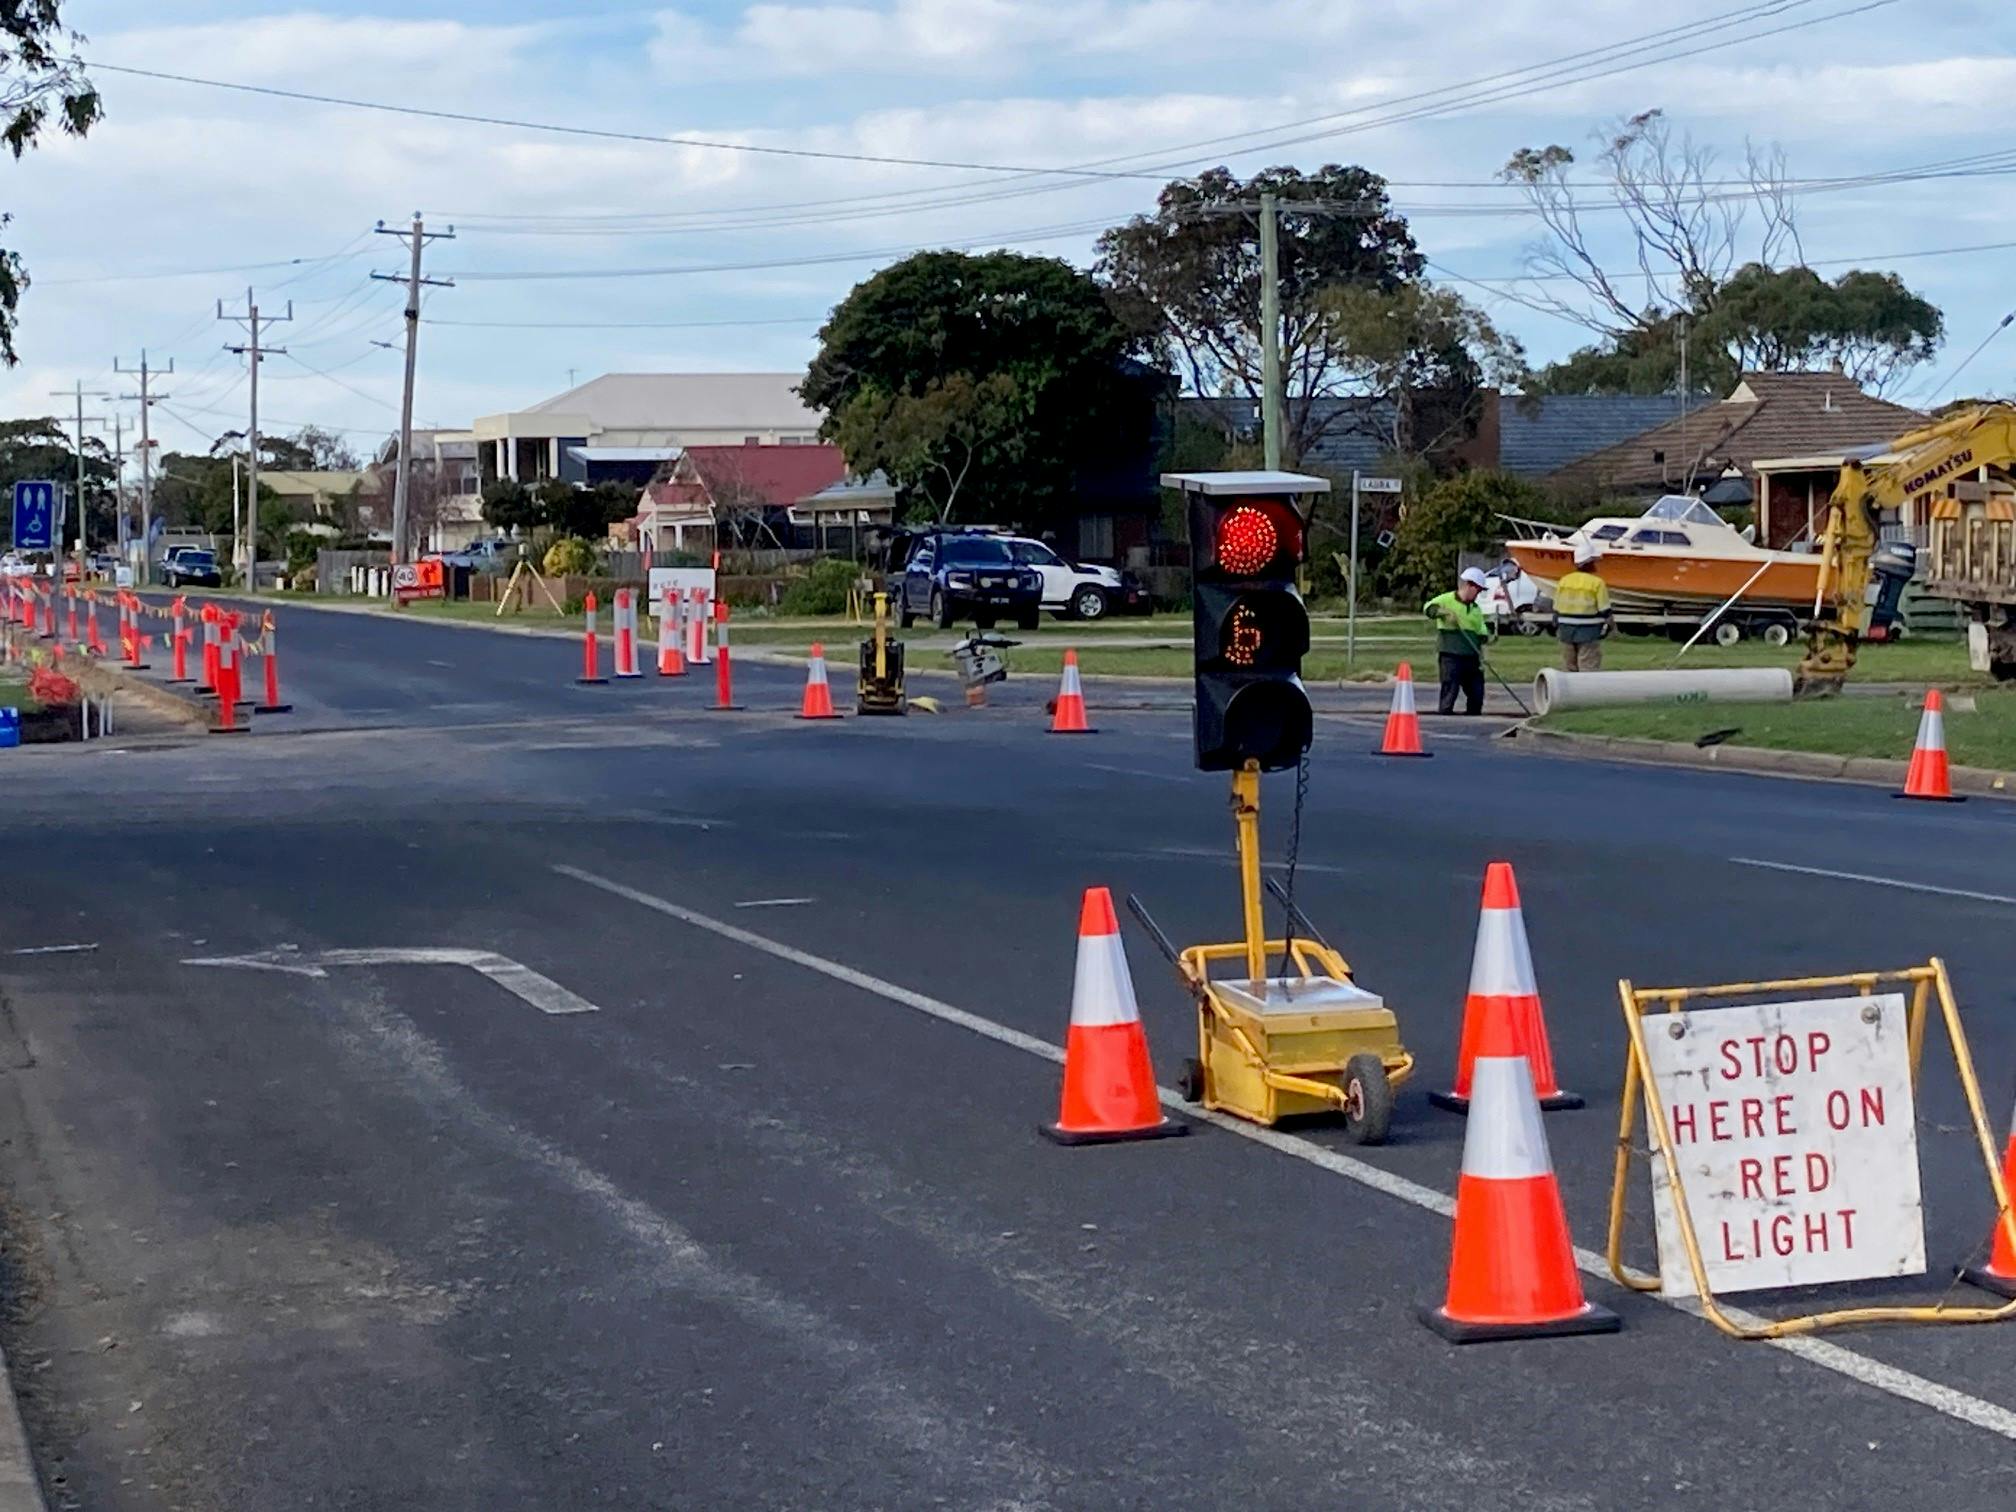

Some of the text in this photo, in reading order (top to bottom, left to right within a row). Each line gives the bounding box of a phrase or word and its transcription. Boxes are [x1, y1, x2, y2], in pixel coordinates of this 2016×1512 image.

[1903, 448, 1973, 495] KOMATSU
[1720, 1032, 1831, 1080] STOP
[1672, 1087, 1886, 1145] HERE ON
[1740, 1153, 1831, 1201] RED
[1721, 1209, 1857, 1261] LIGHT
